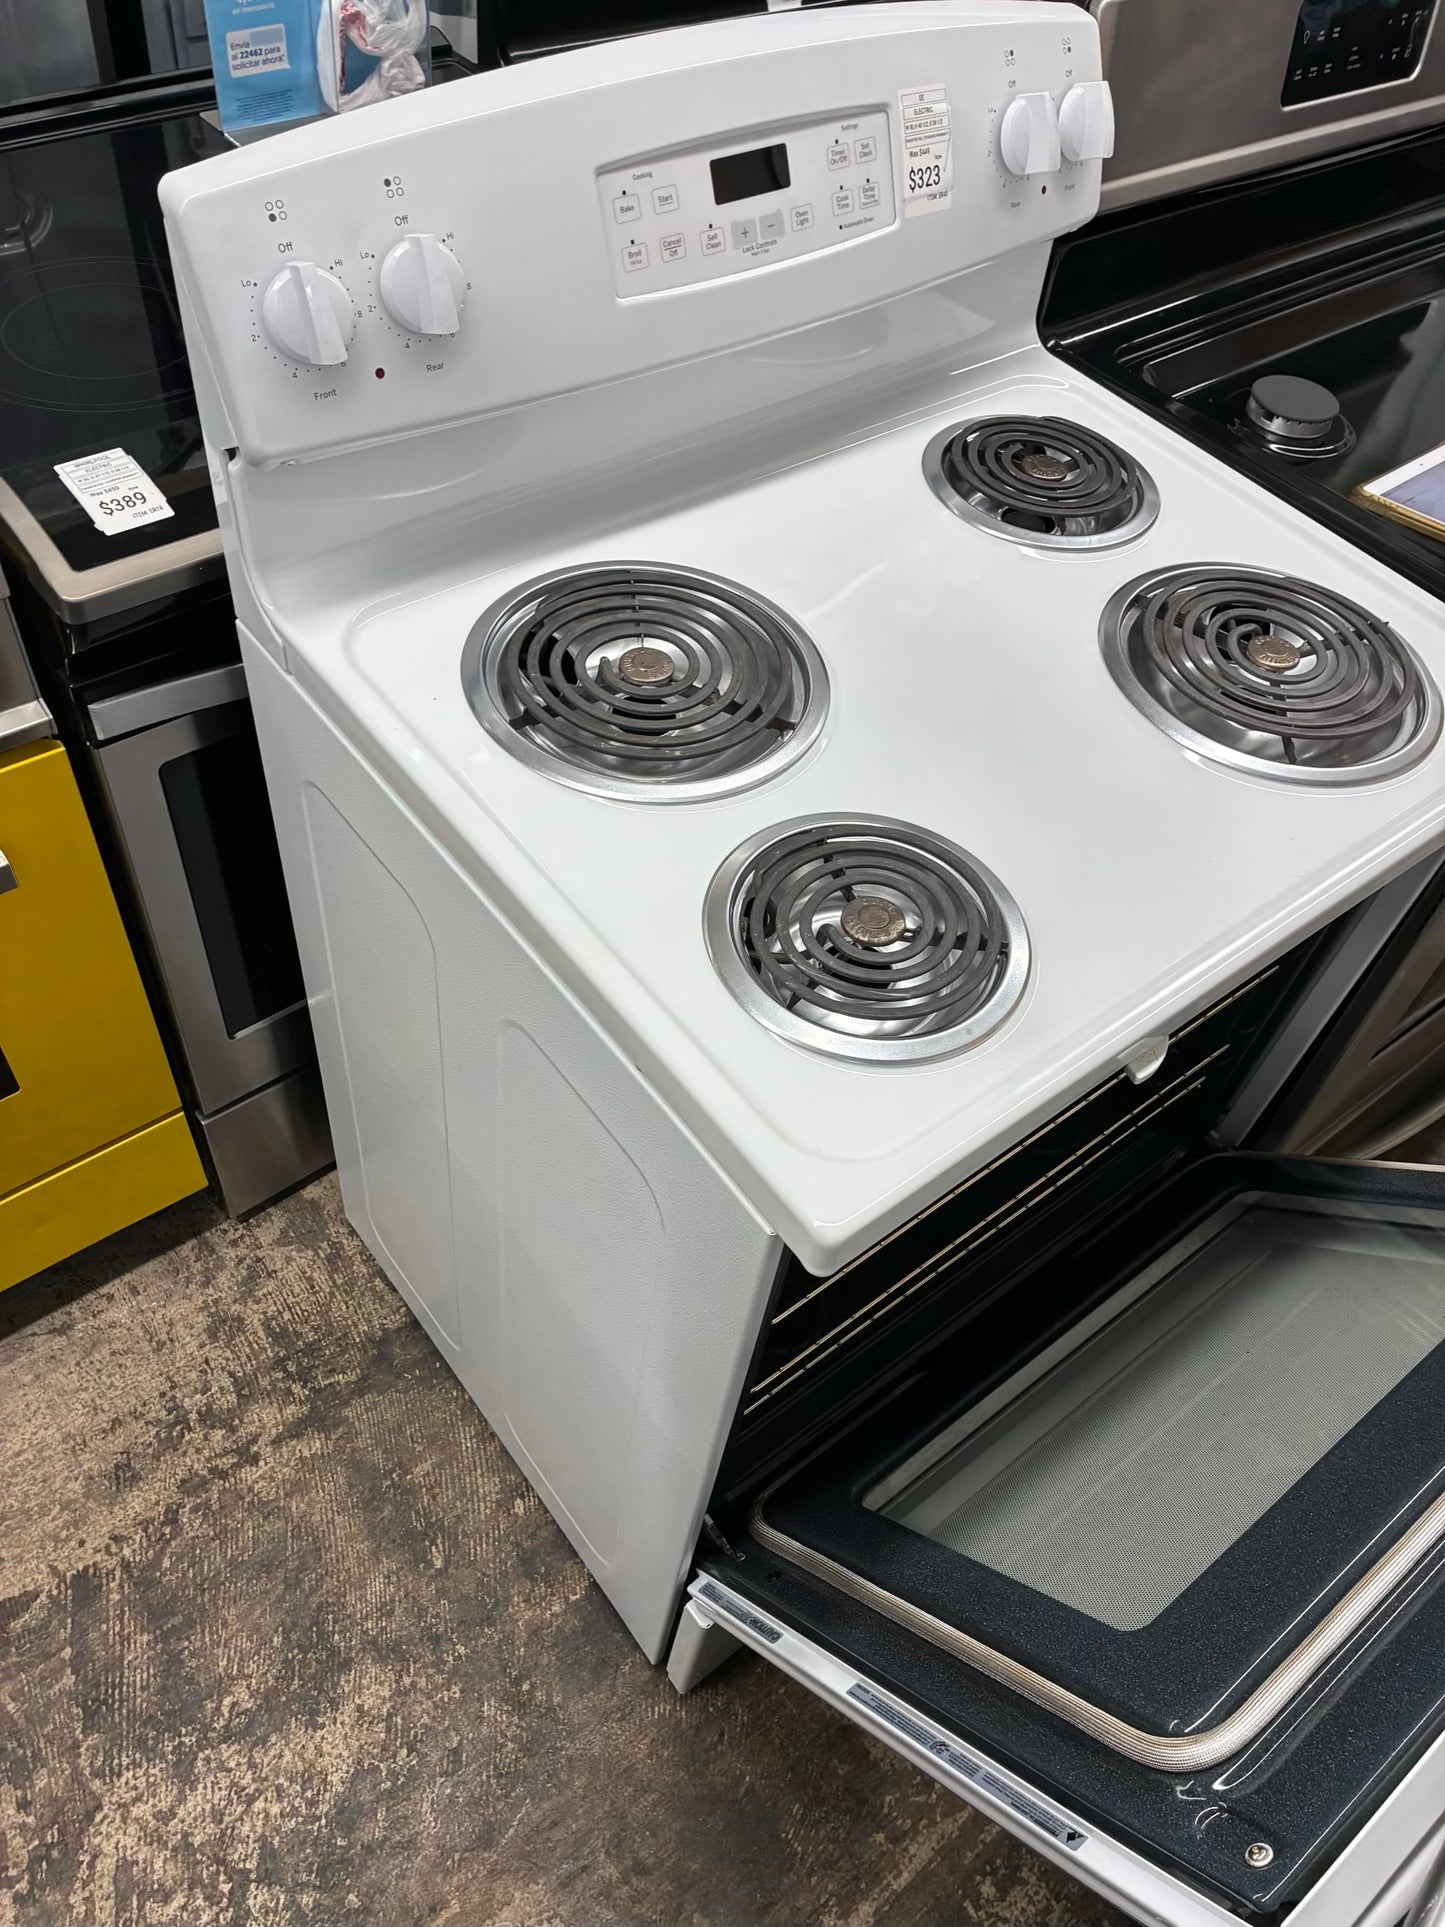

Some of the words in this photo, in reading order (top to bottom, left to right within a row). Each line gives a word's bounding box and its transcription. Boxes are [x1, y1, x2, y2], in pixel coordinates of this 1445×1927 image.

[240, 48, 263, 59] 22462
[264, 46, 281, 56] para
[232, 60, 260, 71] solicitar
[632, 171, 653, 181] Cooking
[909, 165, 941, 193] $323
[658, 194, 673, 203] Start
[620, 204, 635, 214] Bake
[795, 210, 809, 218] Oven
[394, 215, 409, 226] Off
[796, 217, 809, 226] Light
[446, 232, 455, 240] Hi
[707, 233, 718, 242] Self
[662, 236, 682, 248] Cancel
[706, 241, 721, 250] Clean
[742, 245, 754, 254] Lock
[755, 239, 778, 250] Controls
[277, 242, 294, 254] Off
[669, 249, 678, 257] Off
[360, 251, 370, 259] Lo
[628, 249, 642, 259] Broil
[334, 259, 343, 267] Hi
[241, 280, 252, 288] Lo
[357, 310, 363, 318] 8
[368, 305, 374, 313] 2
[251, 334, 257, 342] 2
[426, 362, 445, 373] Rear
[314, 388, 338, 401] Front
[74, 455, 111, 468] WHIRLPOOL
[85, 462, 112, 473] ELECTRIC
[89, 489, 104, 498] Was
[99, 491, 147, 516] $389
